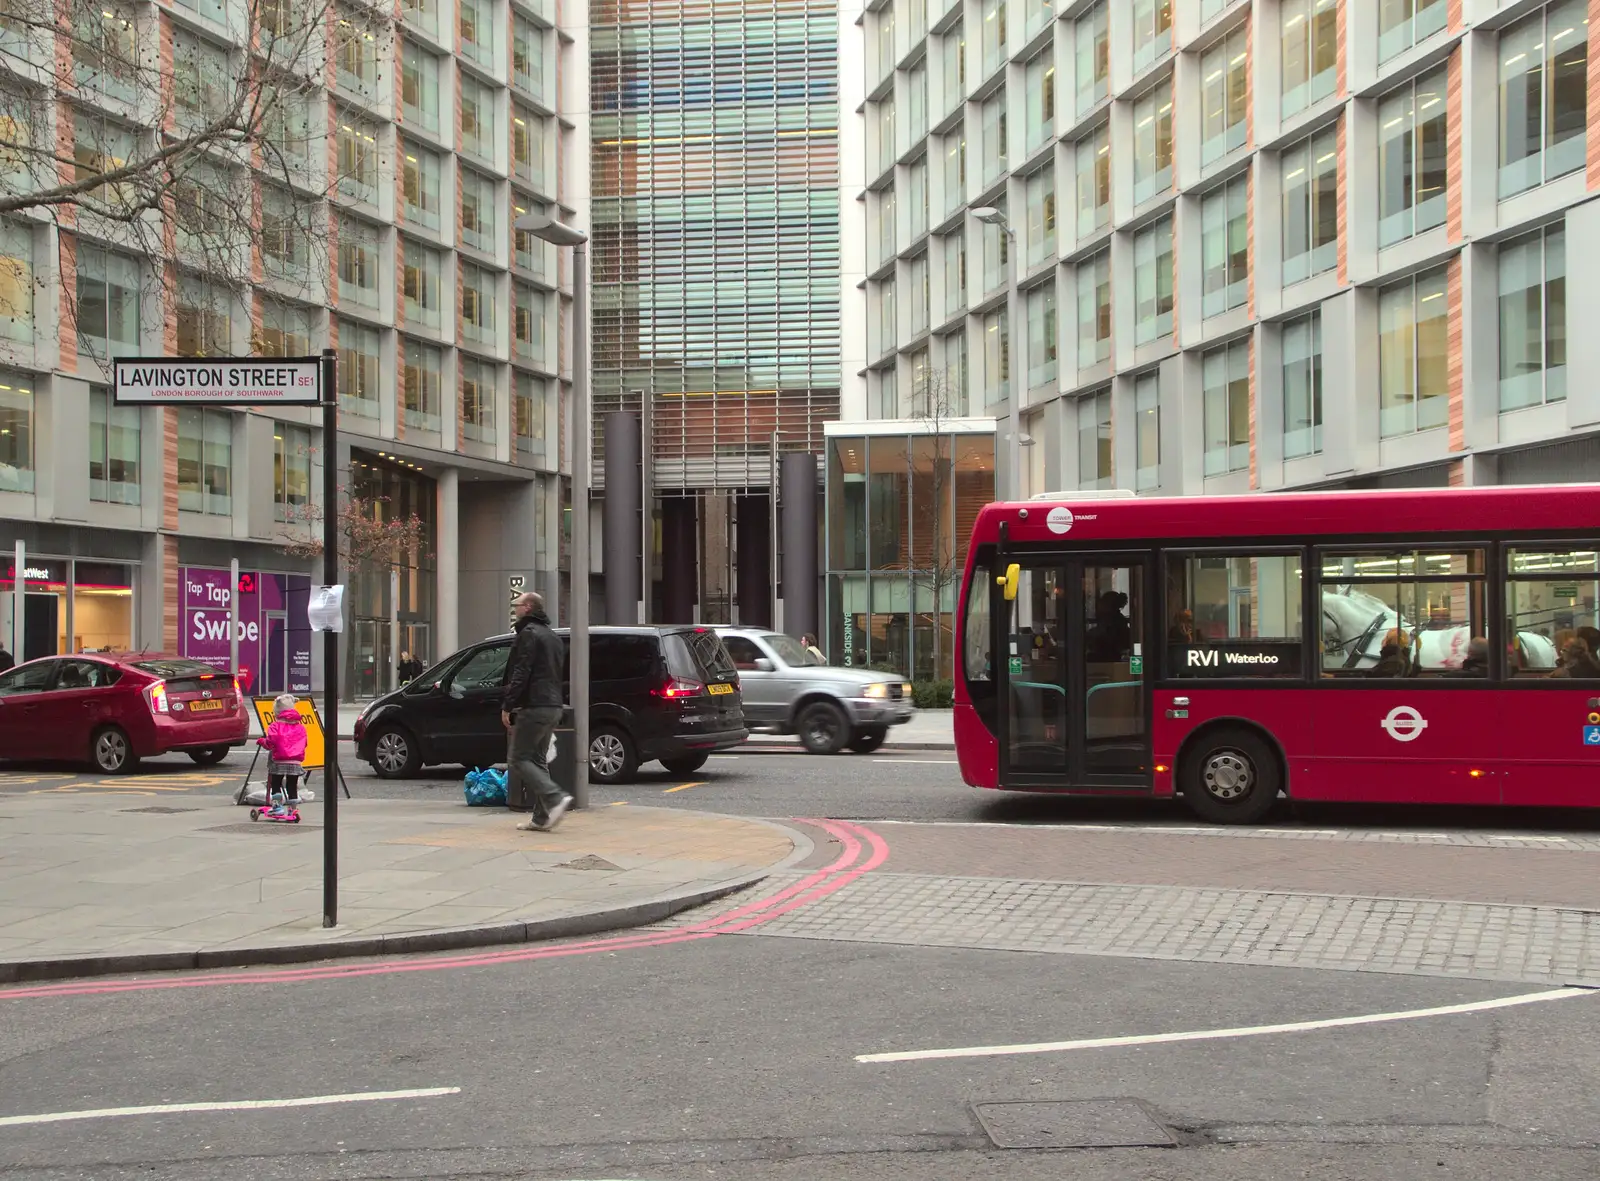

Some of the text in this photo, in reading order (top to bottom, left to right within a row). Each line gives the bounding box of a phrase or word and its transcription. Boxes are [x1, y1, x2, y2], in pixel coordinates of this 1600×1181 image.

[120, 368, 314, 387] LAVINGTON STREET SE1
[24, 567, 49, 579] atWest
[187, 581, 230, 607] Tap Tap
[844, 611, 852, 667] BANKSIDE 3
[1225, 652, 1279, 664] Waterloo
